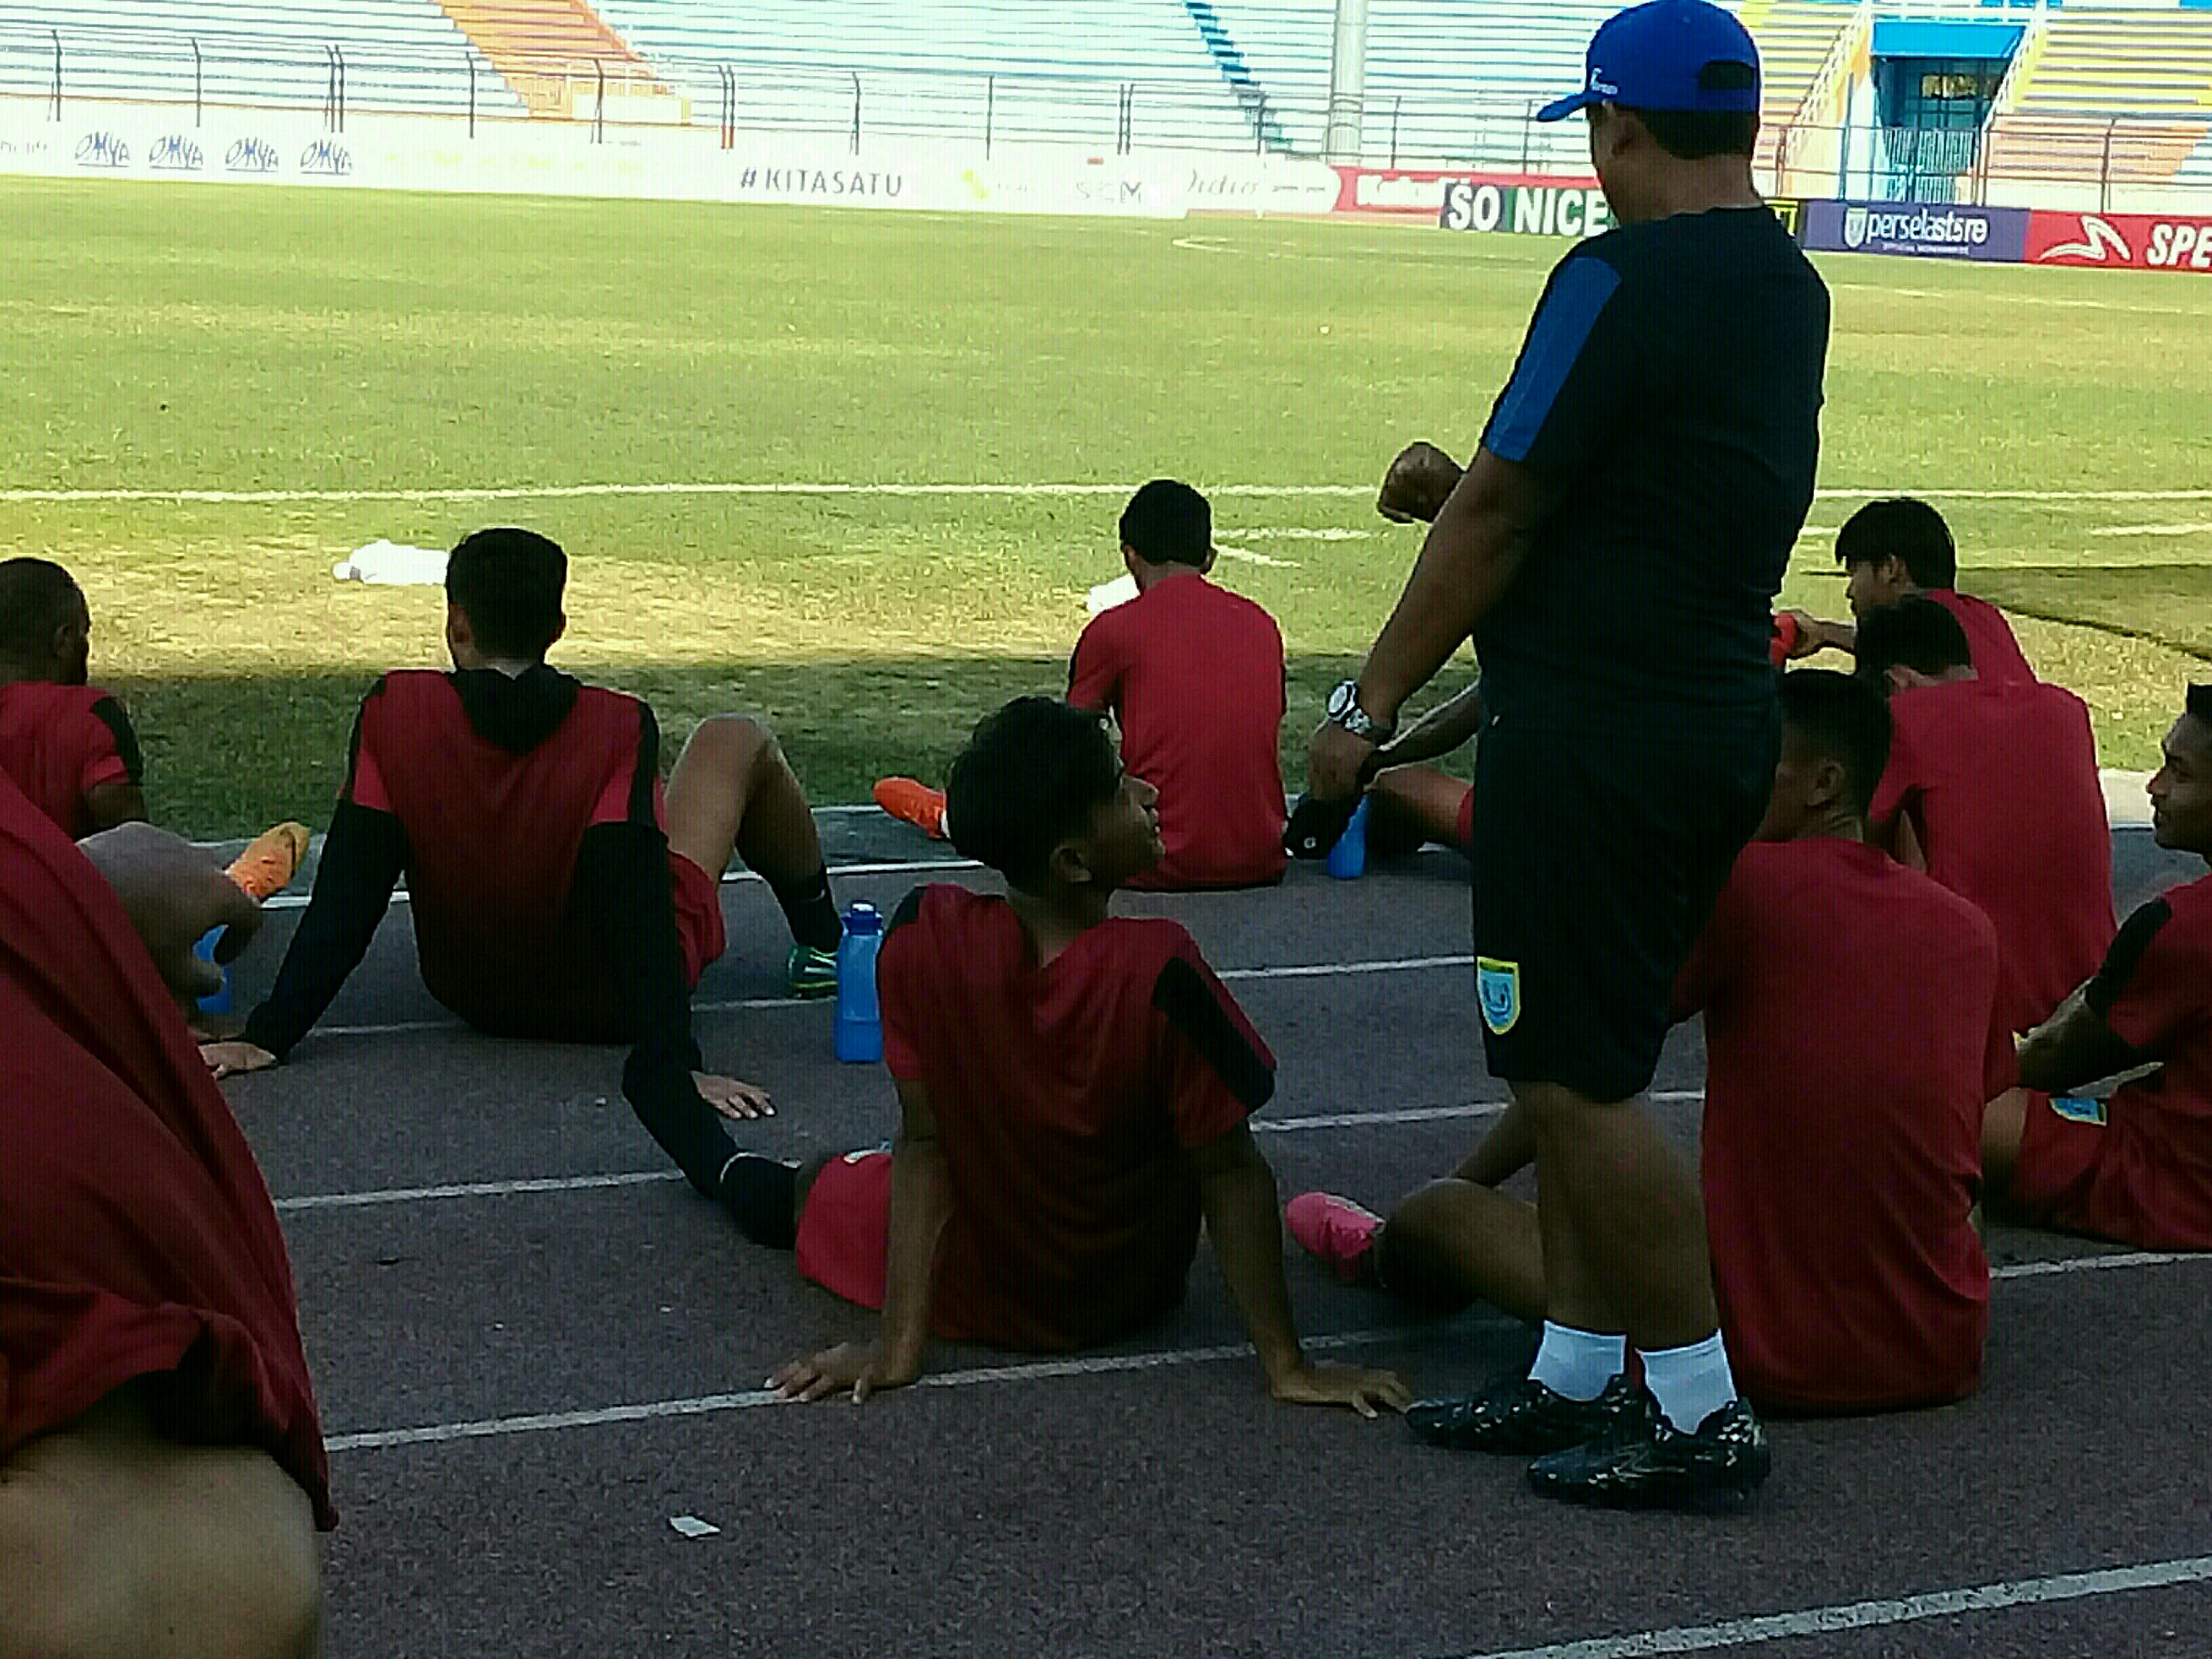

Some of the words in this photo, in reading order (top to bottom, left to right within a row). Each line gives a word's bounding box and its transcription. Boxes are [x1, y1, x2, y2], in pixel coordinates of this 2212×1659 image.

[740, 167, 902, 197] #KITASATU
[1448, 184, 1500, 231] SO
[1515, 186, 1608, 237] NICE
[2146, 224, 2212, 267] SPE
